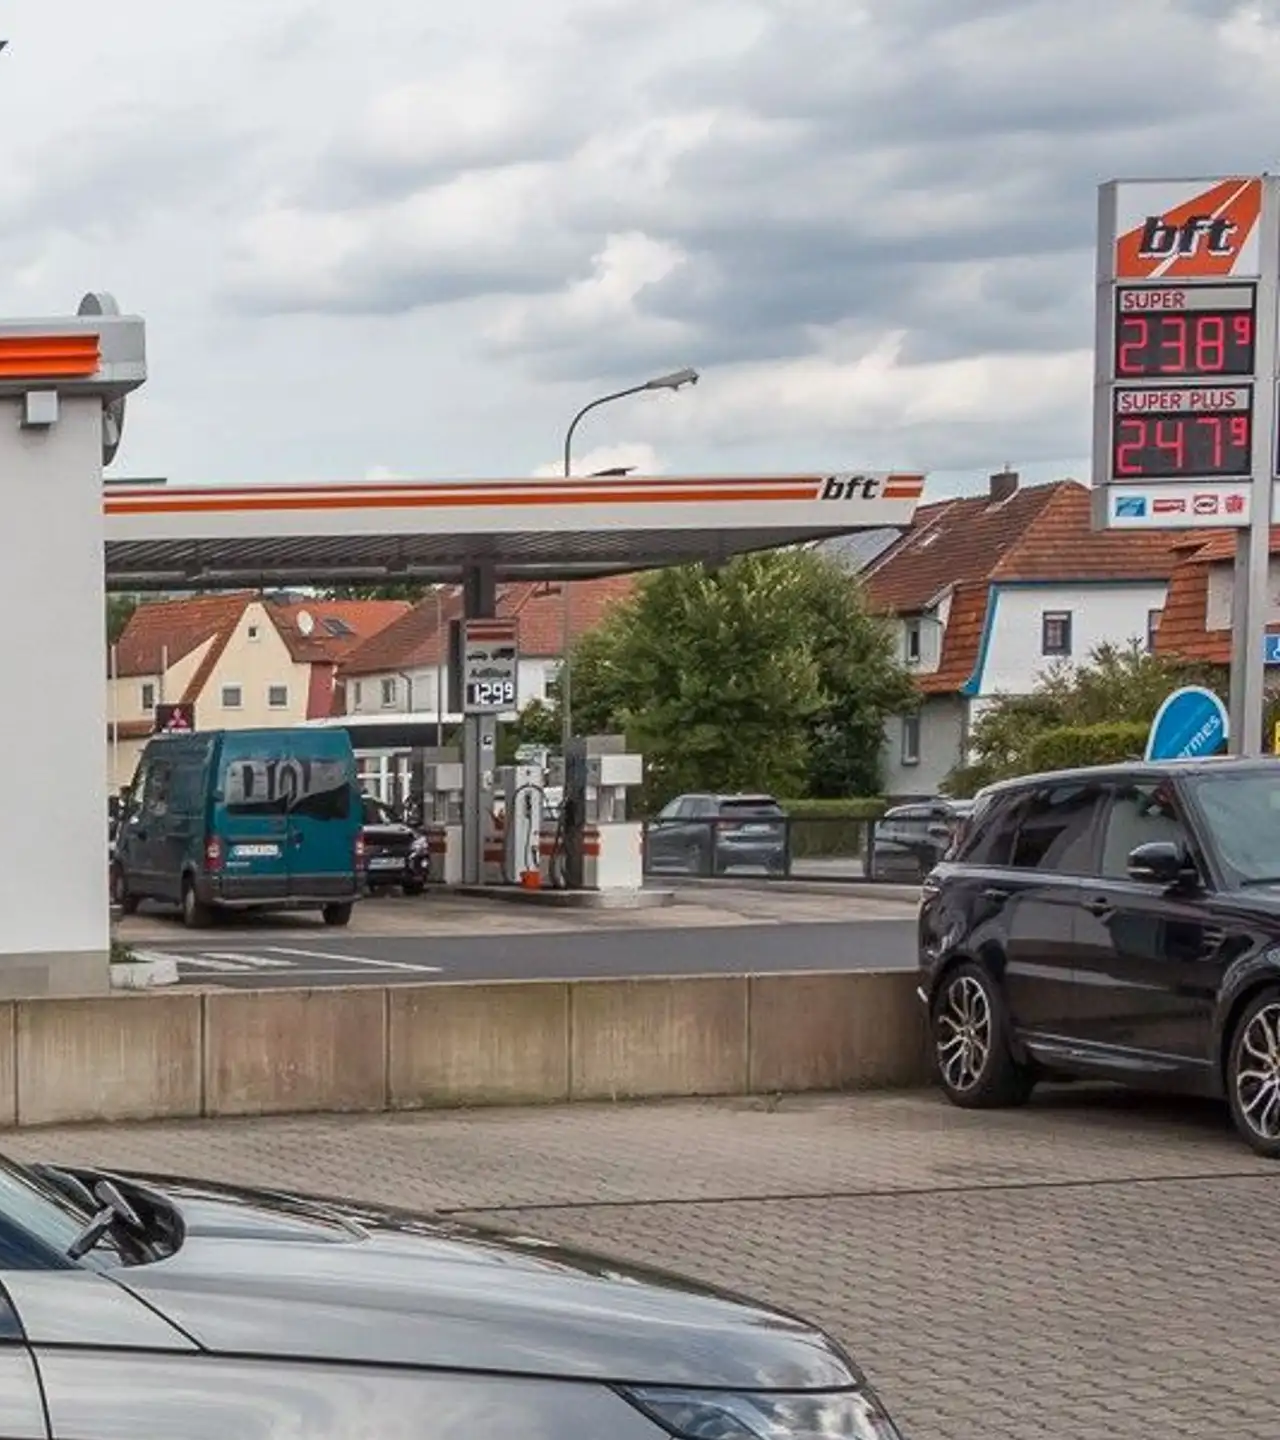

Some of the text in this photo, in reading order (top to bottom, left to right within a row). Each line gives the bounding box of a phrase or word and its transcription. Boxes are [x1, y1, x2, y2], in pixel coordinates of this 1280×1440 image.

[1138, 216, 1239, 257] bft
[1124, 292, 1185, 308] SUPER
[1121, 391, 1237, 410] SUPER PLUS
[821, 475, 880, 500] bft
